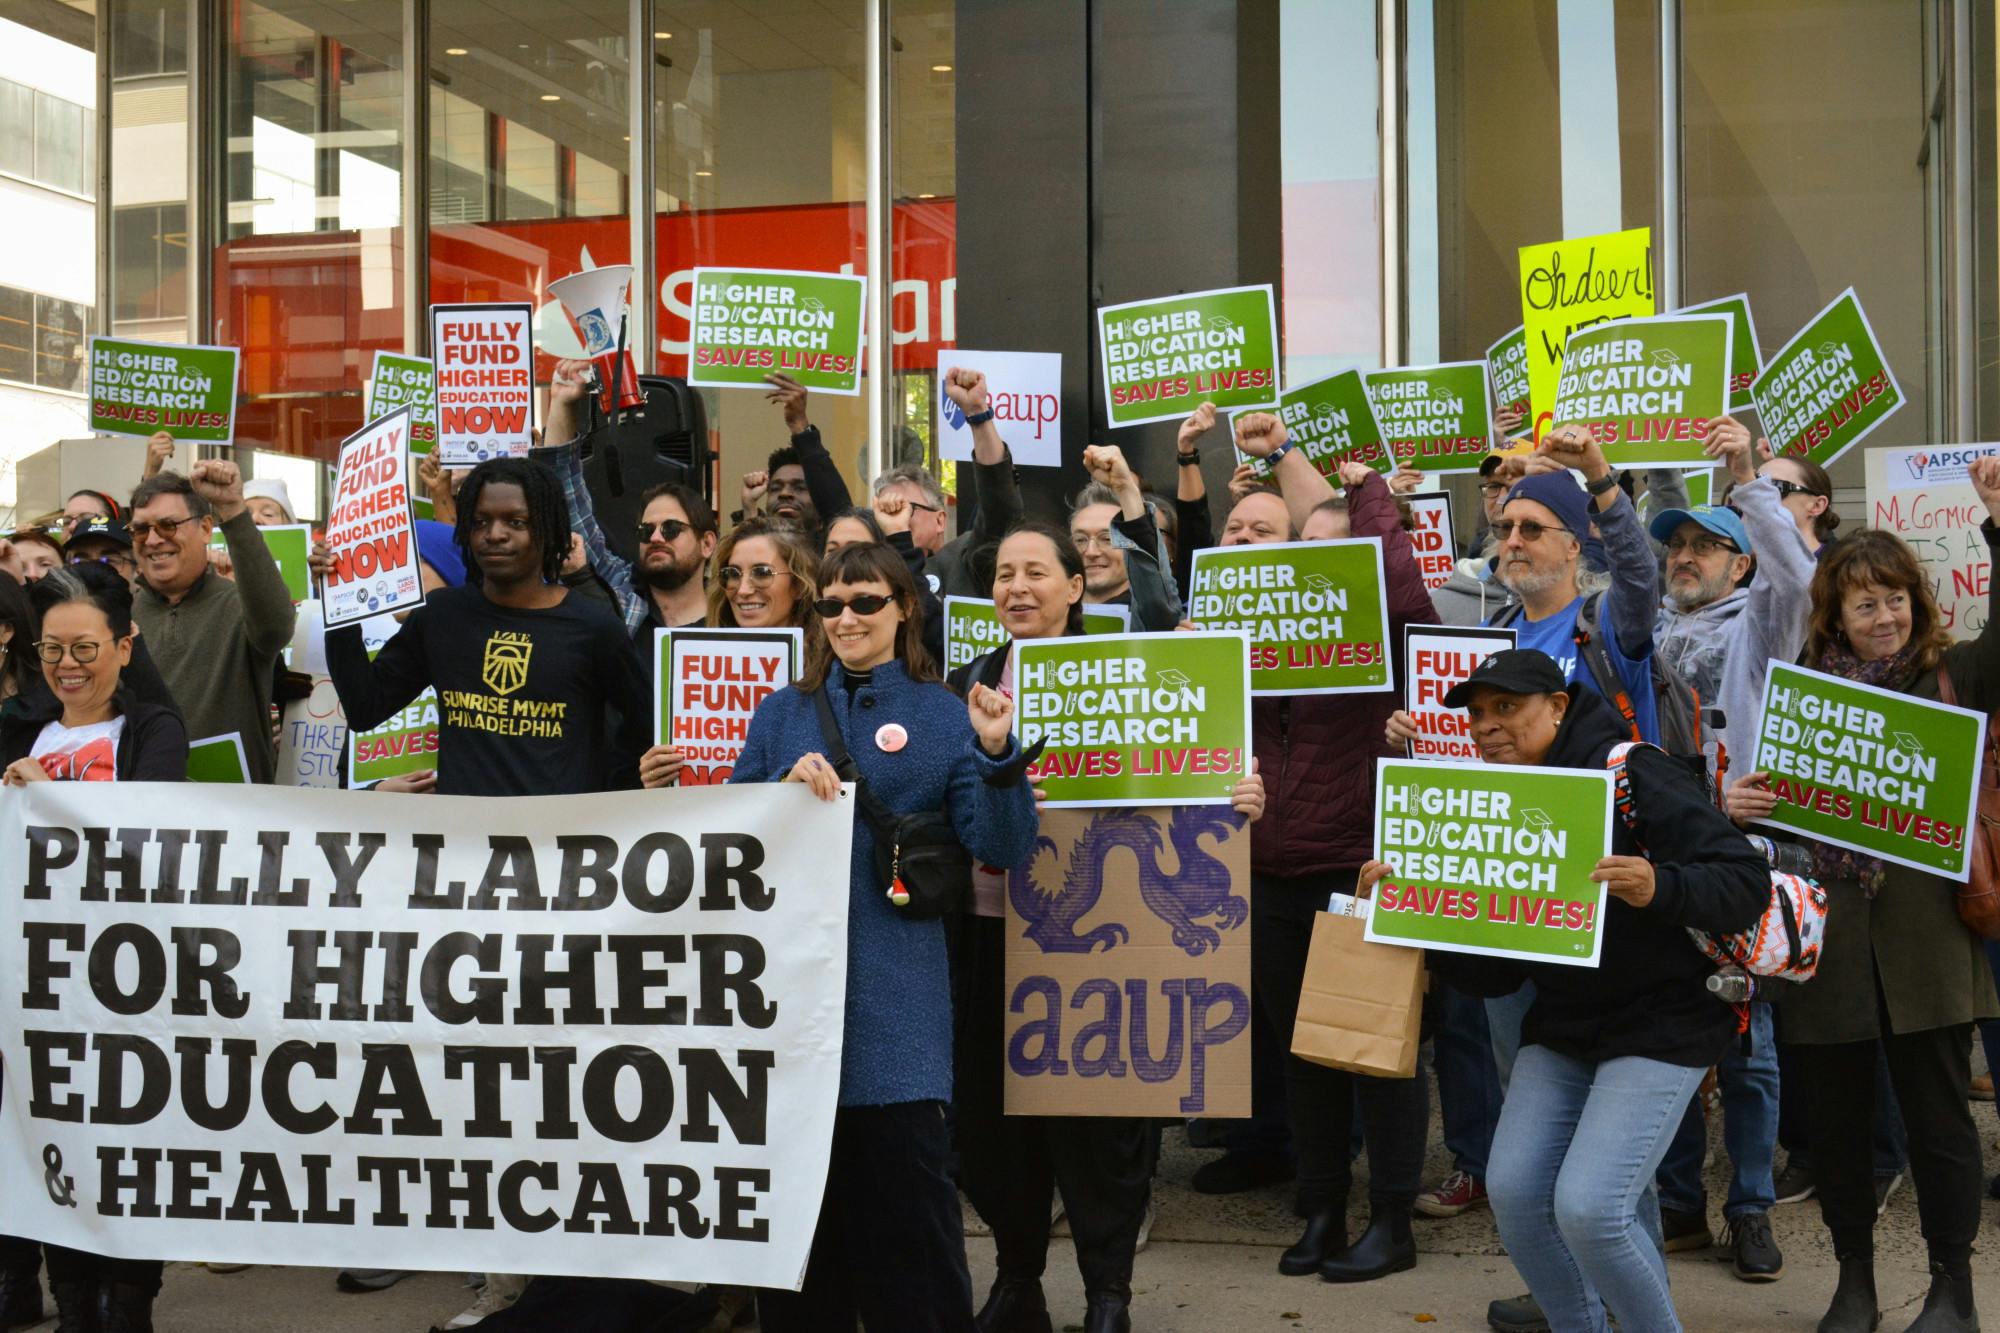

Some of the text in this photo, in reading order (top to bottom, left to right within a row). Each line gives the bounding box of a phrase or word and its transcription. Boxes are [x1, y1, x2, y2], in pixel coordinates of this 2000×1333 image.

[700, 283, 796, 306] HIGHER
[1526, 246, 1653, 311] Oh deer!
[442, 322, 522, 342] FULLY
[698, 304, 835, 330] EDUCATION
[1106, 310, 1202, 343] HIGHER
[697, 326, 828, 350] RESEARCH
[1108, 326, 1245, 364] EDUCATION
[94, 349, 178, 372] HIGHER
[444, 344, 520, 365] FUND
[696, 347, 855, 375] SAVES LIVES!
[1110, 348, 1242, 384] RESEARCH
[1563, 339, 1644, 374] HIGHER
[93, 367, 212, 393] EDUCATION
[378, 365, 432, 388] HIGH
[438, 369, 528, 388] HIGHER
[1112, 367, 1273, 406] SAVES LIVES!
[1367, 380, 1429, 401] HIGHER
[1558, 363, 1692, 399] EDUCATION
[1756, 347, 1816, 414] HIGHER
[1763, 341, 1854, 434] EDUCATION
[93, 384, 206, 410] RESEARCH
[439, 391, 528, 404] EDUCATION
[1375, 397, 1464, 420] DUCATION
[1553, 390, 1684, 424] RESEARCH
[1770, 366, 1860, 454] RESEARCH
[1829, 369, 1892, 429] LIVES!
[95, 402, 229, 429] SAVES LIVES!
[441, 406, 528, 435] NOW
[1286, 408, 1350, 443] ATION
[1626, 417, 1709, 443] LIVES
[341, 427, 402, 478] FULLY
[1421, 436, 1489, 456] LIVES!
[337, 456, 398, 503] FUND
[328, 483, 406, 530] HIGHER
[1408, 531, 1443, 552] ND
[1906, 530, 1981, 563] IS A
[327, 529, 409, 588] NOW
[1195, 564, 1296, 592] HIGHER
[1952, 563, 1989, 600] NE
[1192, 588, 1348, 618] EDUCATION
[950, 615, 1006, 643] HIGH
[682, 655, 781, 682] FULLY
[1288, 641, 1383, 669] LIVES!
[1022, 657, 1147, 689] HIGHER
[442, 690, 567, 718] SUNRISE MVMT
[1022, 686, 1206, 718] EDUCATION
[1768, 684, 1886, 739] HIGHER
[291, 721, 345, 751] THRE
[447, 710, 563, 738] PHILADELPHIA
[674, 716, 749, 741] HIGH
[1022, 717, 1198, 748] RESEARCH
[1410, 711, 1473, 737] HIGH
[356, 730, 439, 764] SAVES
[676, 745, 742, 762] EDUCA
[1025, 746, 1243, 779] SAVES LIVES!
[1413, 739, 1481, 758] EDUCAT
[1763, 713, 1937, 783] EDUCATION
[1758, 742, 1926, 810] RESEARCH
[1384, 784, 1512, 820] HIGHER
[1383, 817, 1567, 859] EDUCATION
[1860, 799, 1964, 852] LIVES!
[23, 825, 776, 914] PHILLY LABOR
[1383, 850, 1557, 892] RESEARCH
[1378, 883, 1596, 933] SAVES LIVES!
[22, 921, 778, 1030] FOR HIGHER
[1008, 975, 1251, 1113] aaup
[24, 1029, 776, 1146] EDUCATION
[42, 1142, 771, 1244] & HEALTHCARE
